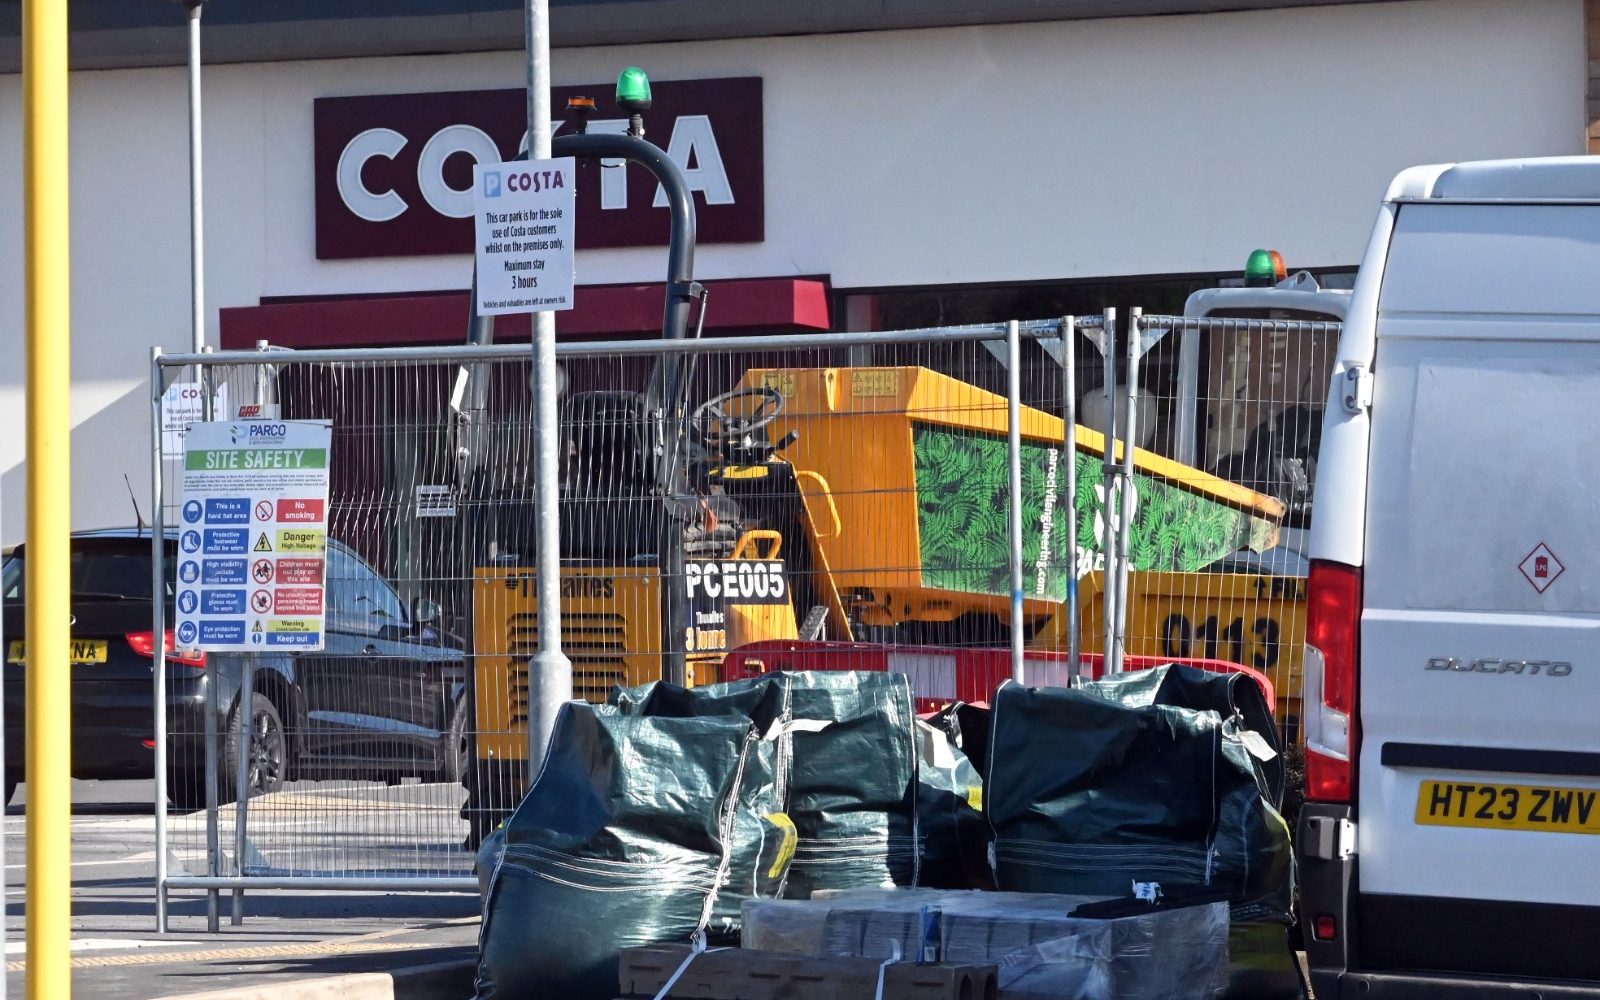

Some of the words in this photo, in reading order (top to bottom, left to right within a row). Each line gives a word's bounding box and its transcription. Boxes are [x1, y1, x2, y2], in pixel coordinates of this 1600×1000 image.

[336, 114, 735, 222] COTA
[507, 170, 564, 192] COSTA
[486, 212, 498, 224] This
[498, 214, 508, 222] car
[509, 210, 522, 224] park
[523, 210, 528, 221] is
[529, 210, 538, 220] for
[540, 208, 550, 220] the
[550, 208, 562, 219] sole
[492, 229, 502, 238] use
[503, 226, 509, 237] of
[510, 226, 526, 237] Costa
[527, 225, 556, 236] customers
[485, 242, 503, 254] whilst
[504, 243, 511, 253] on
[512, 241, 522, 252] the
[523, 239, 548, 253] premises
[550, 238, 564, 250] only.
[504, 260, 532, 271] Maximum
[533, 259, 545, 271] stay
[512, 276, 516, 289] 3
[518, 276, 537, 289] hours
[483, 300, 498, 308] Vehicles
[250, 424, 286, 436] PARCO
[206, 451, 238, 469] SITE
[244, 450, 304, 468] SAFETY
[285, 511, 315, 519] smoking
[284, 532, 315, 542] Danger
[294, 569, 306, 577] play
[686, 563, 784, 598] PCE005
[277, 635, 294, 643] Keep
[685, 627, 694, 651] 3
[696, 627, 725, 650] tonne
[1163, 614, 1280, 668] 0113
[1425, 657, 1572, 676] DUCATO
[1429, 784, 1520, 820] HT23
[1528, 790, 1596, 825] ZWV
